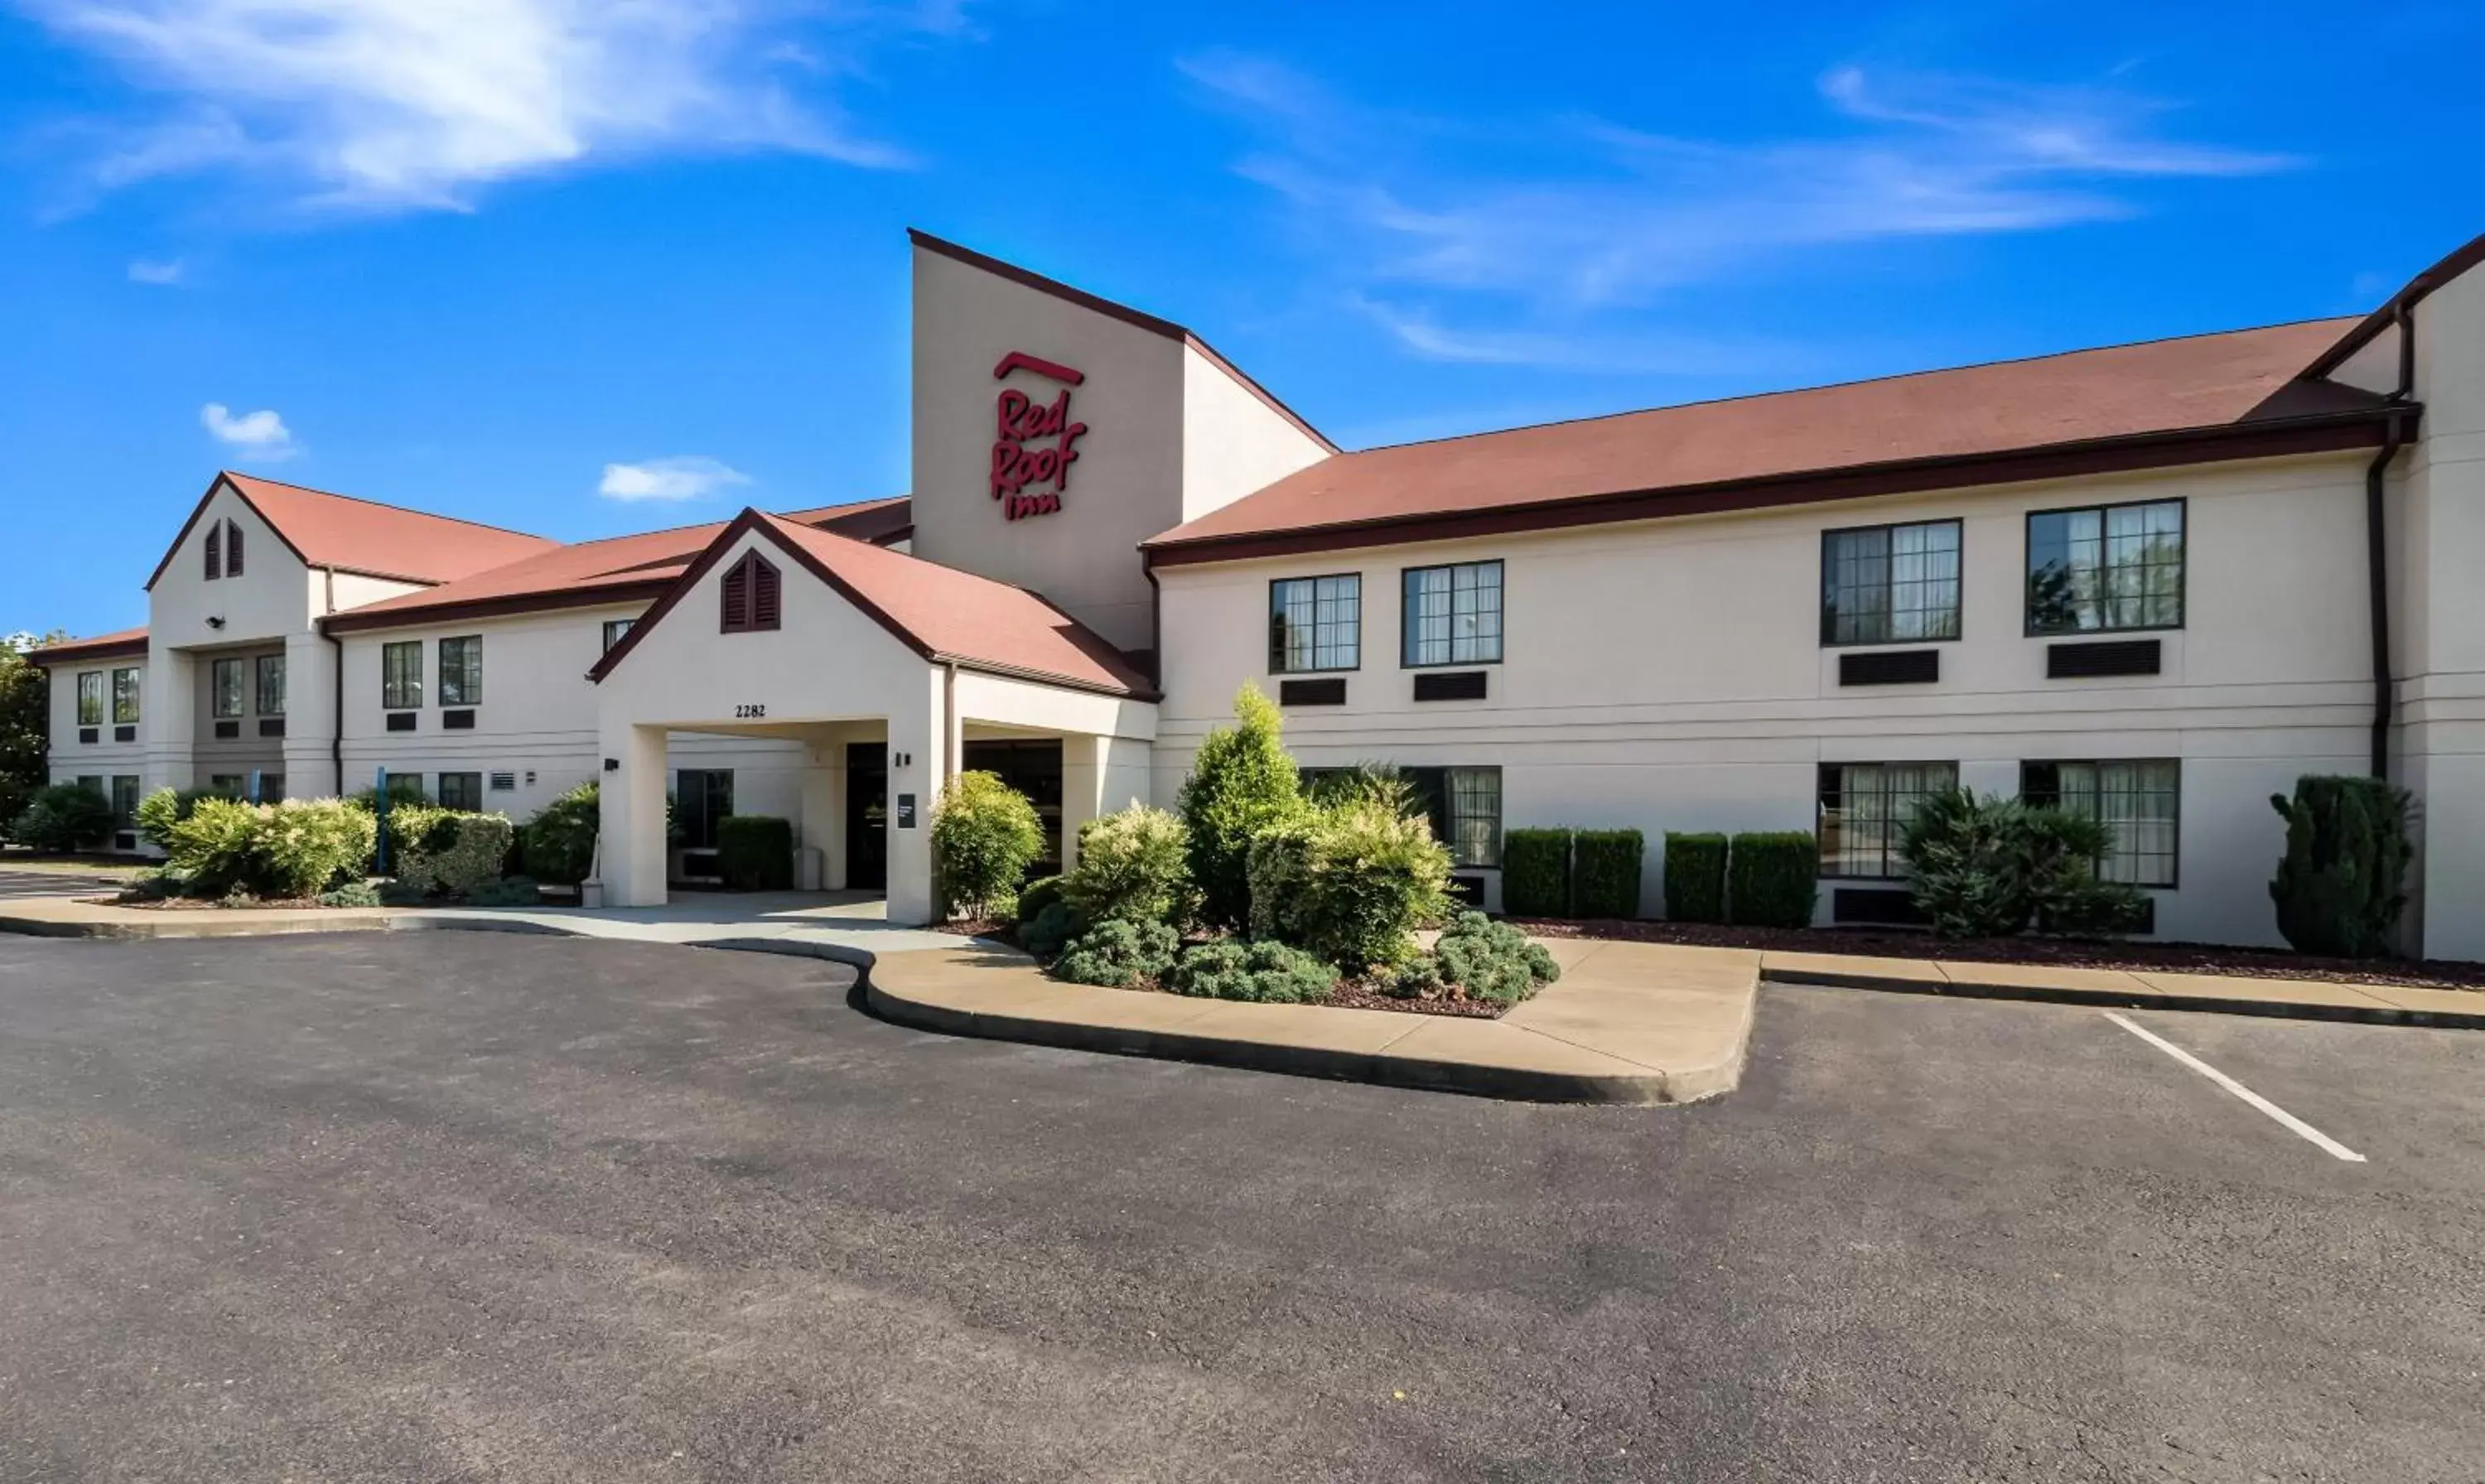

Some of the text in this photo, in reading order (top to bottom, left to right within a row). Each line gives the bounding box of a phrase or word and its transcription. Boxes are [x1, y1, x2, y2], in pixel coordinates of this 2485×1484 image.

[998, 389, 1070, 441] Red
[992, 422, 1087, 500] Roof
[1004, 494, 1060, 521] Inn
[736, 705, 765, 718] 2282
